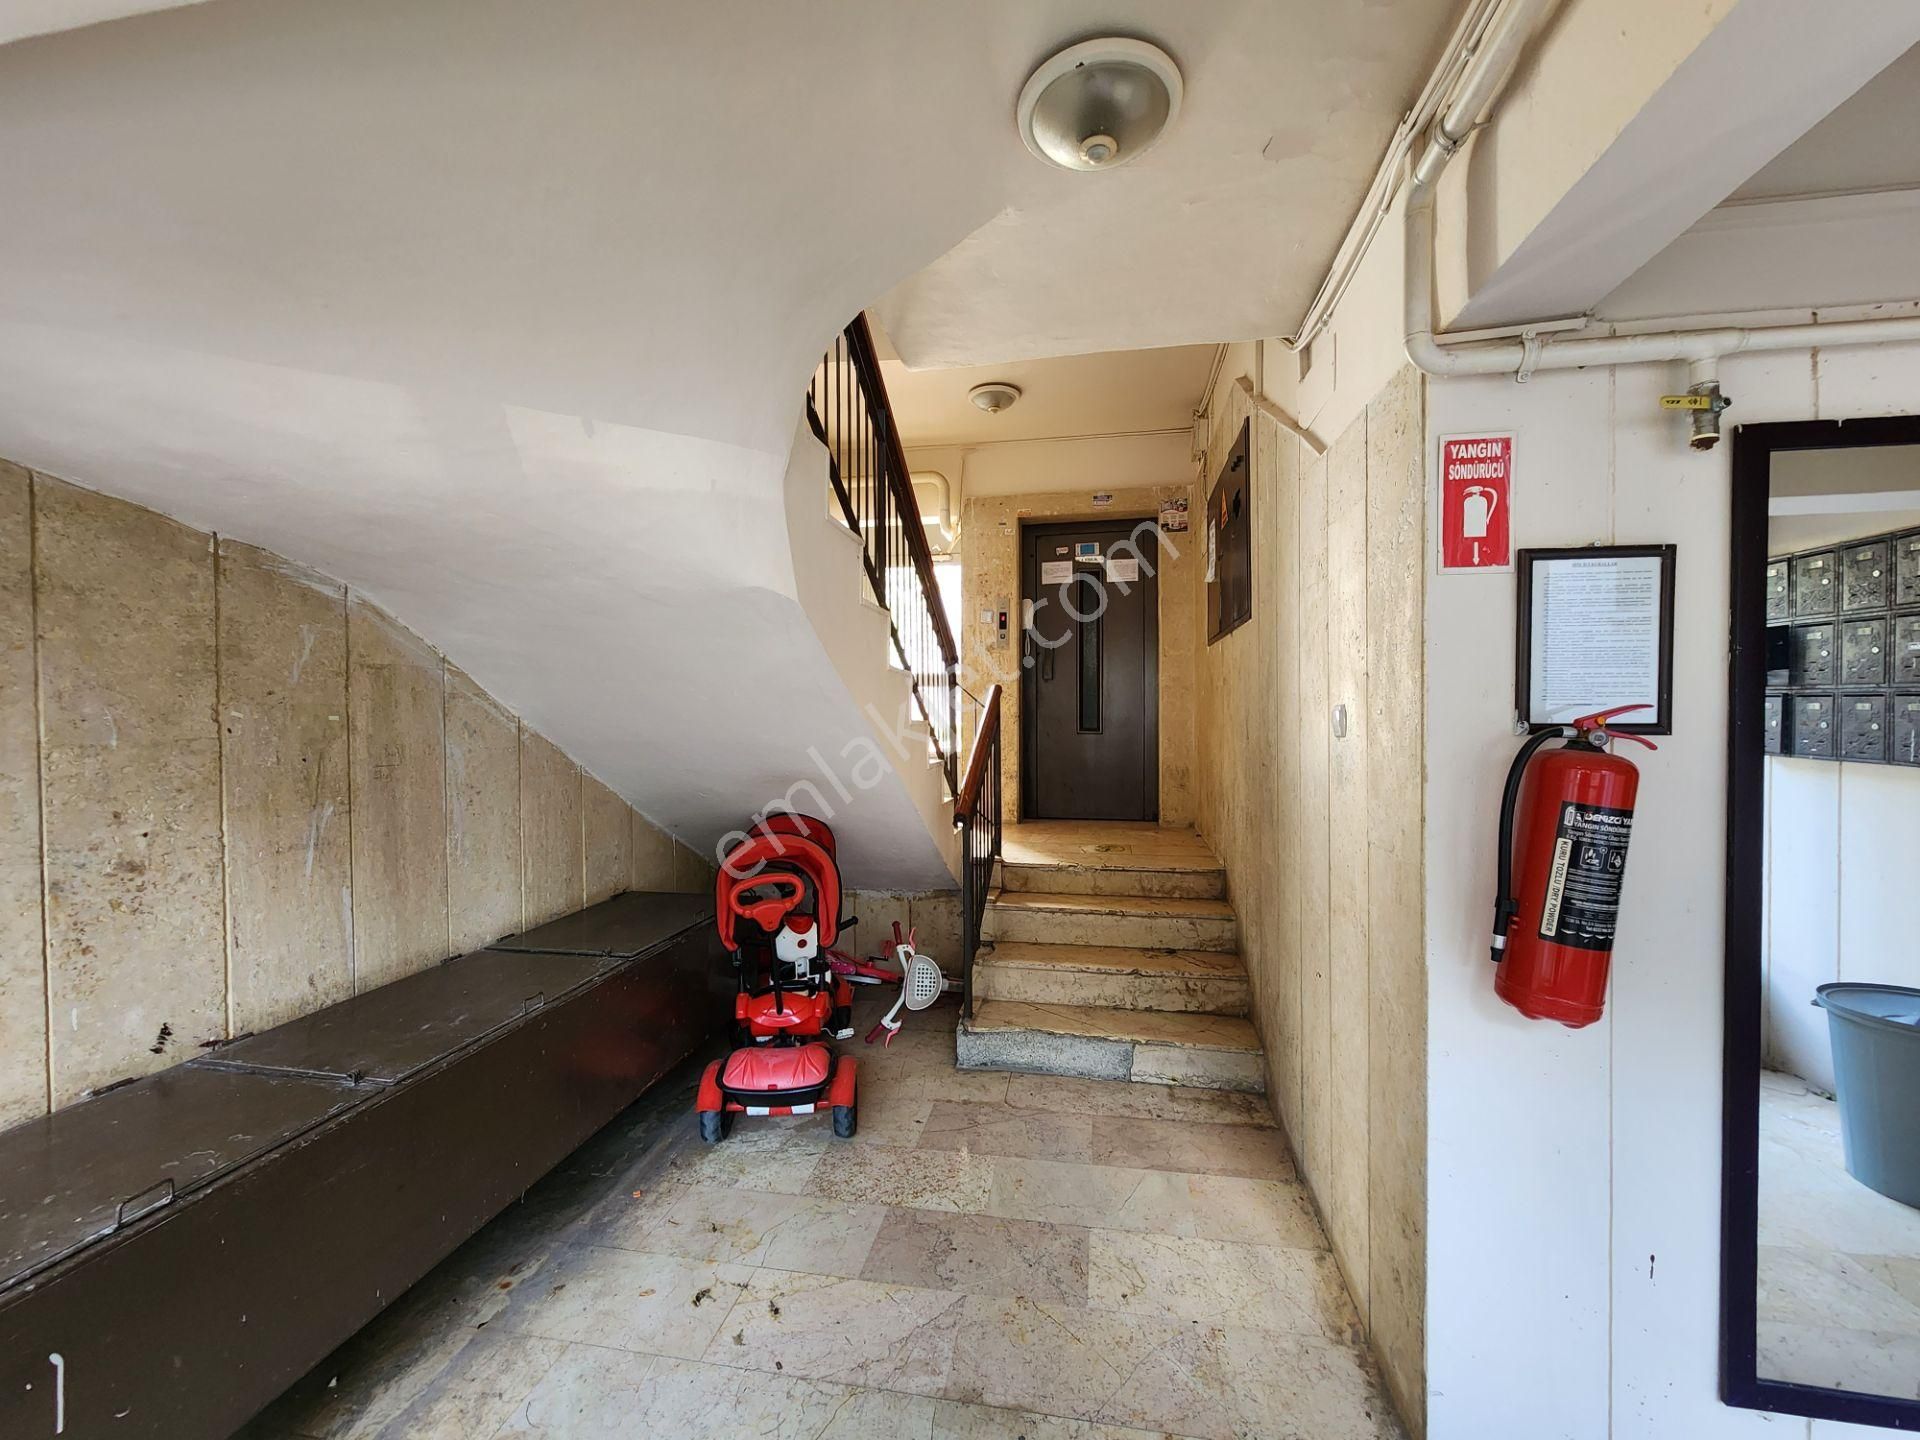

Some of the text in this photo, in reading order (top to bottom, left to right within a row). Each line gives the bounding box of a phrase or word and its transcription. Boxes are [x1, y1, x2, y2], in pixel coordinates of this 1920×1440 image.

[1450, 442, 1502, 459] YANGIN
[1448, 459, 1505, 480] SÖNDÜRÜCÜ
[1573, 821, 1599, 831] YANGIN
[1558, 841, 1569, 861] KURU
[1554, 862, 1566, 886] TOZLU
[1543, 903, 1557, 932] POWDER
